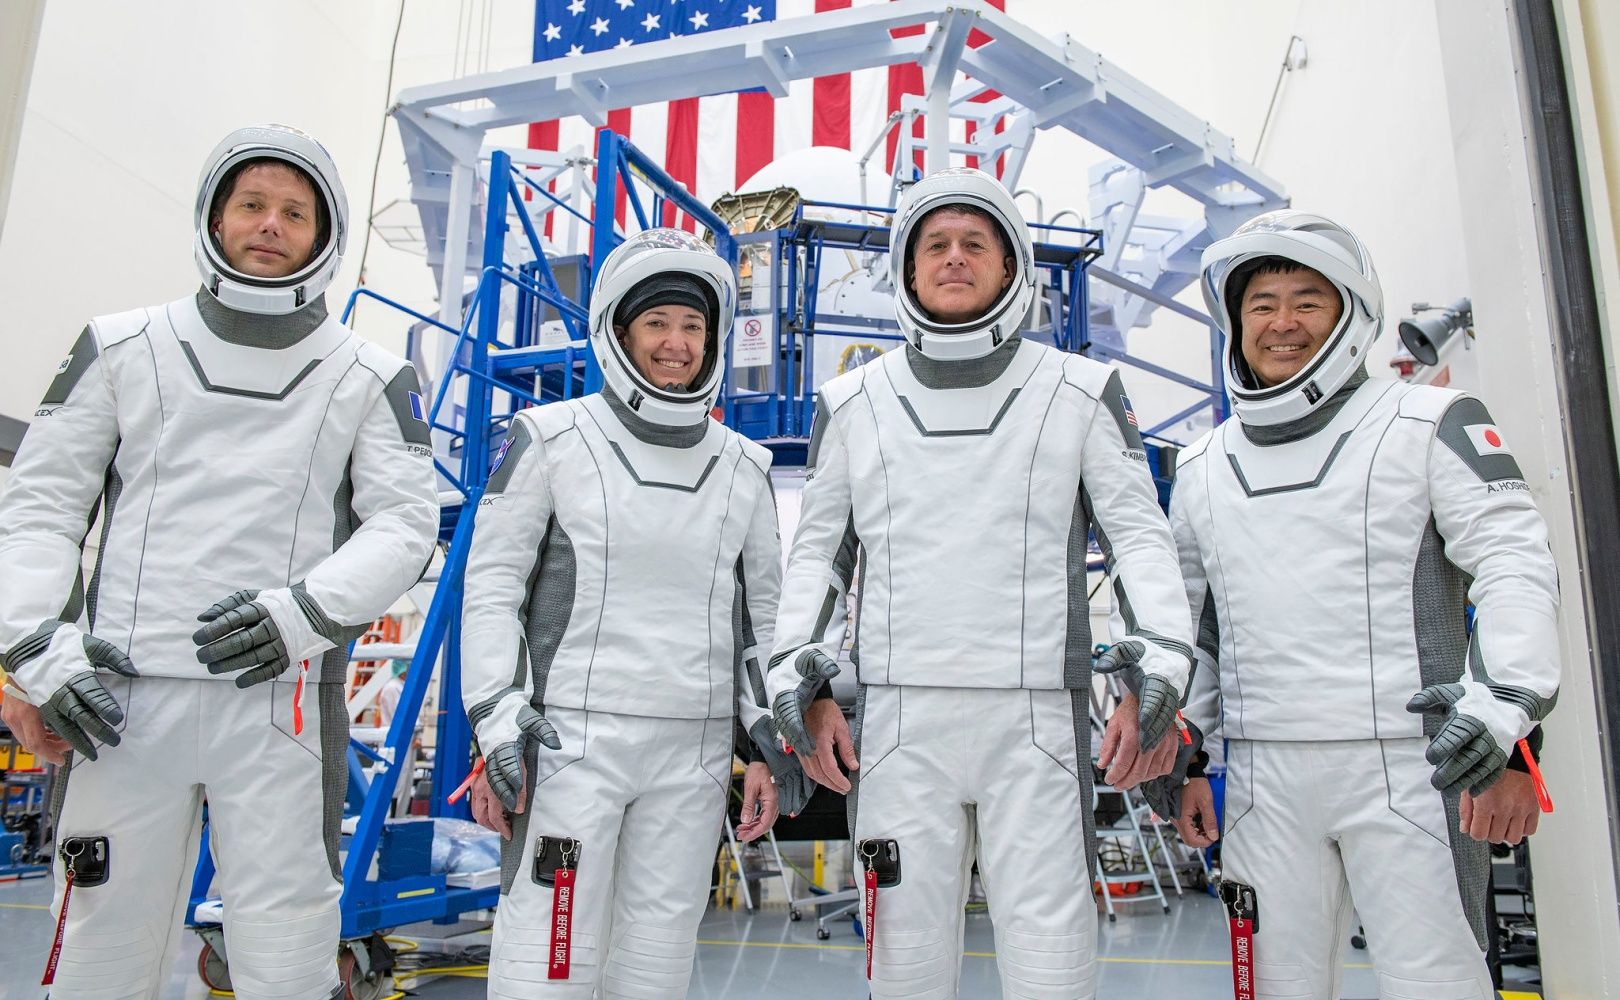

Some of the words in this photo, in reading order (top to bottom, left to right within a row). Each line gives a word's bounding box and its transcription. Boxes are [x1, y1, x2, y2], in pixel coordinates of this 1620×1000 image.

[557, 886, 570, 913] REMOVE
[556, 914, 568, 940] BEFORE
[1236, 936, 1248, 964] REMOVE
[1237, 964, 1250, 992] BEFORE
